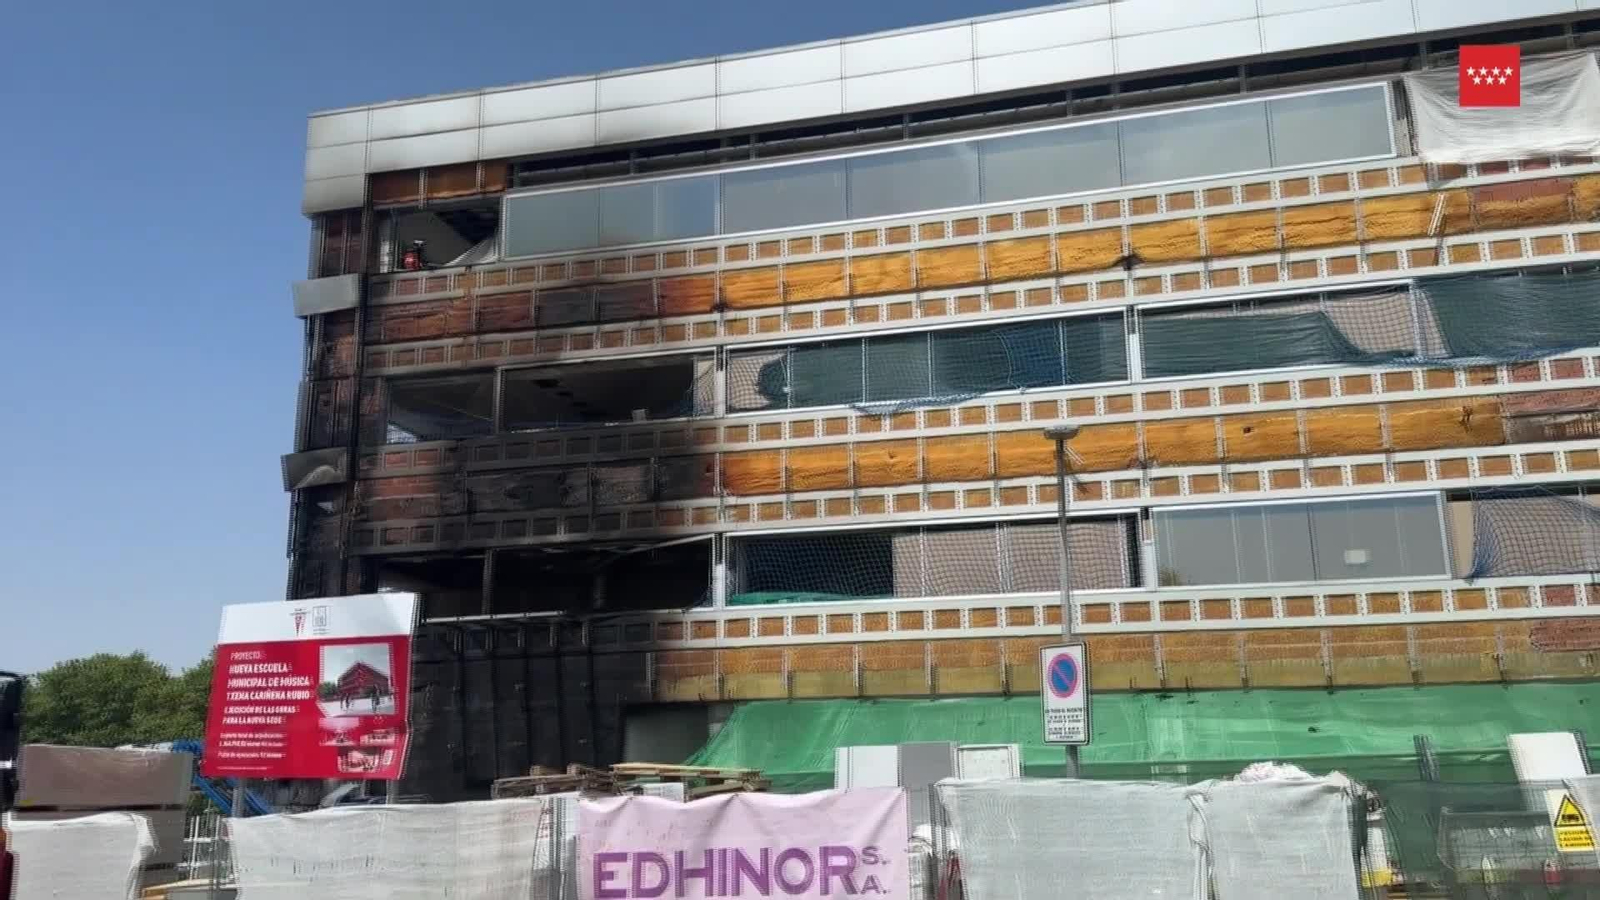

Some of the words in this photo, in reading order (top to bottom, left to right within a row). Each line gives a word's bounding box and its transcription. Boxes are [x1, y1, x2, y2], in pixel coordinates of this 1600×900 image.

[229, 664, 252, 674] NUEVA
[254, 663, 288, 673] ESCUELA
[227, 677, 267, 688] MUNICIPAL
[268, 677, 279, 687] DE
[287, 690, 310, 700] RUBIO
[593, 846, 858, 899] EDHINOR
